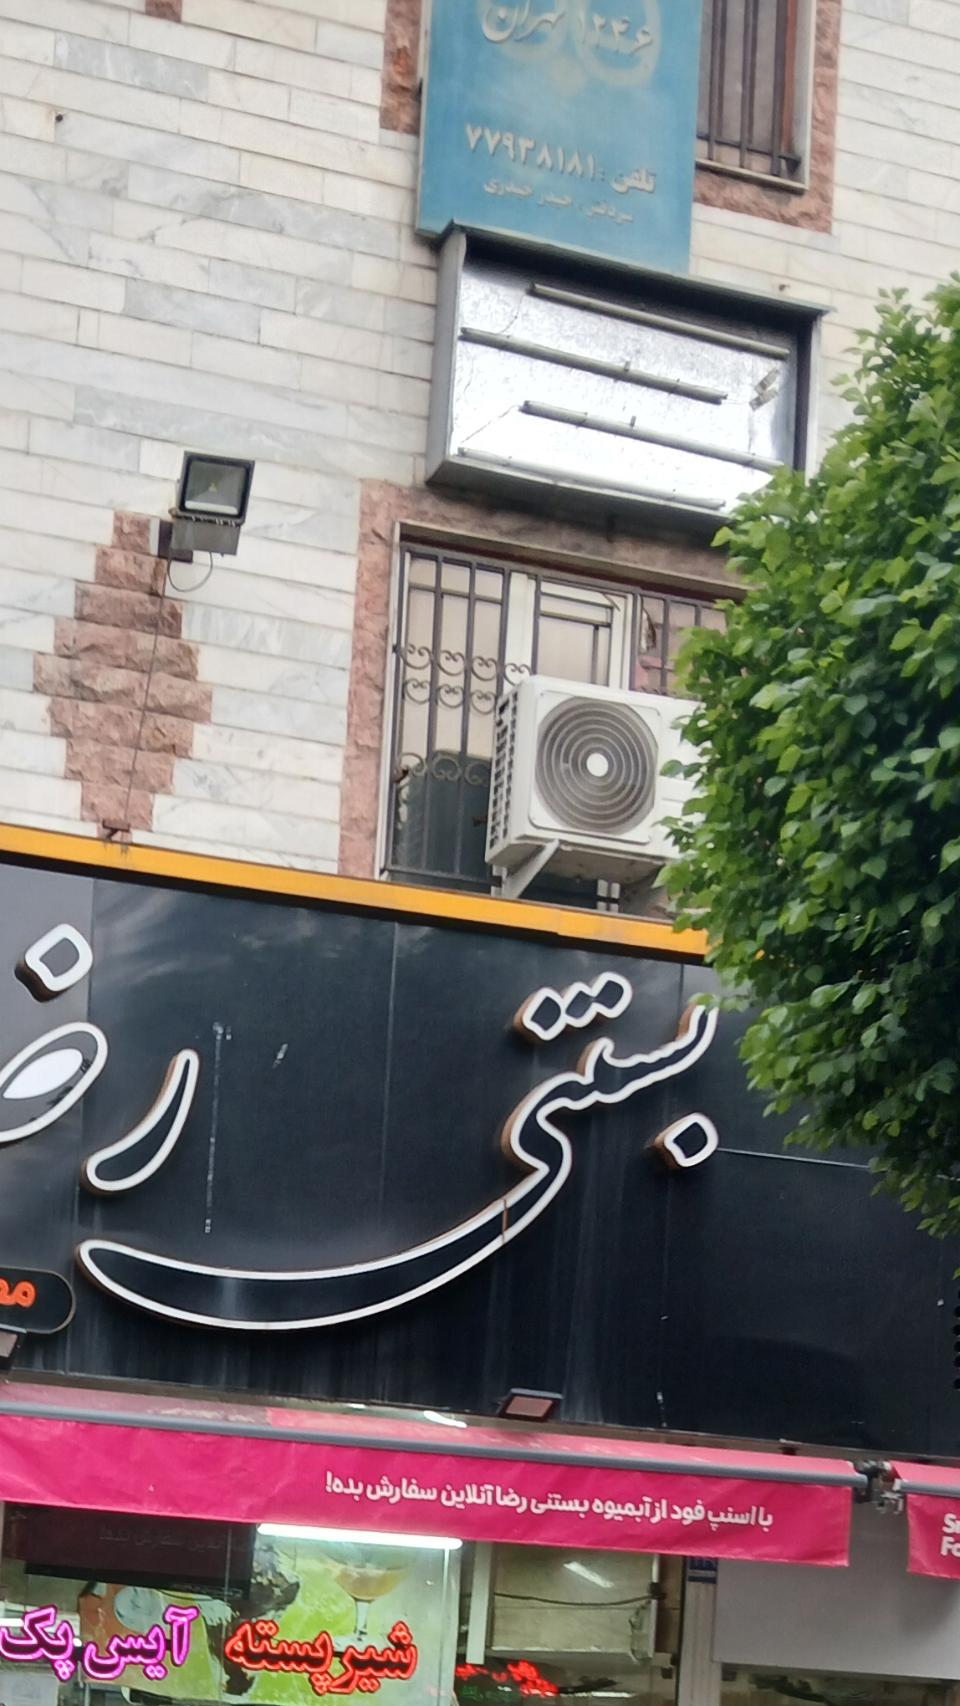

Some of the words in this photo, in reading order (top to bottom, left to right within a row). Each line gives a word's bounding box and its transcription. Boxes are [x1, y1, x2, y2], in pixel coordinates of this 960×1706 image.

[465, 123, 598, 181] ۷۷۹۳۸۱۸۱
[75, 971, 721, 1332] بستنی
[325, 1470, 364, 1501] بده!
[365, 1475, 438, 1505] سفارش
[440, 1484, 494, 1510] آنلاین
[495, 1485, 528, 1514] رضا
[530, 1492, 590, 1519] بستنی
[591, 1496, 652, 1522] آبمیوه
[649, 1498, 668, 1524] از
[670, 1498, 706, 1526] فود
[706, 1504, 756, 1532] اسنپ
[758, 1505, 774, 1532] با
[81, 1603, 199, 1681] آیس
